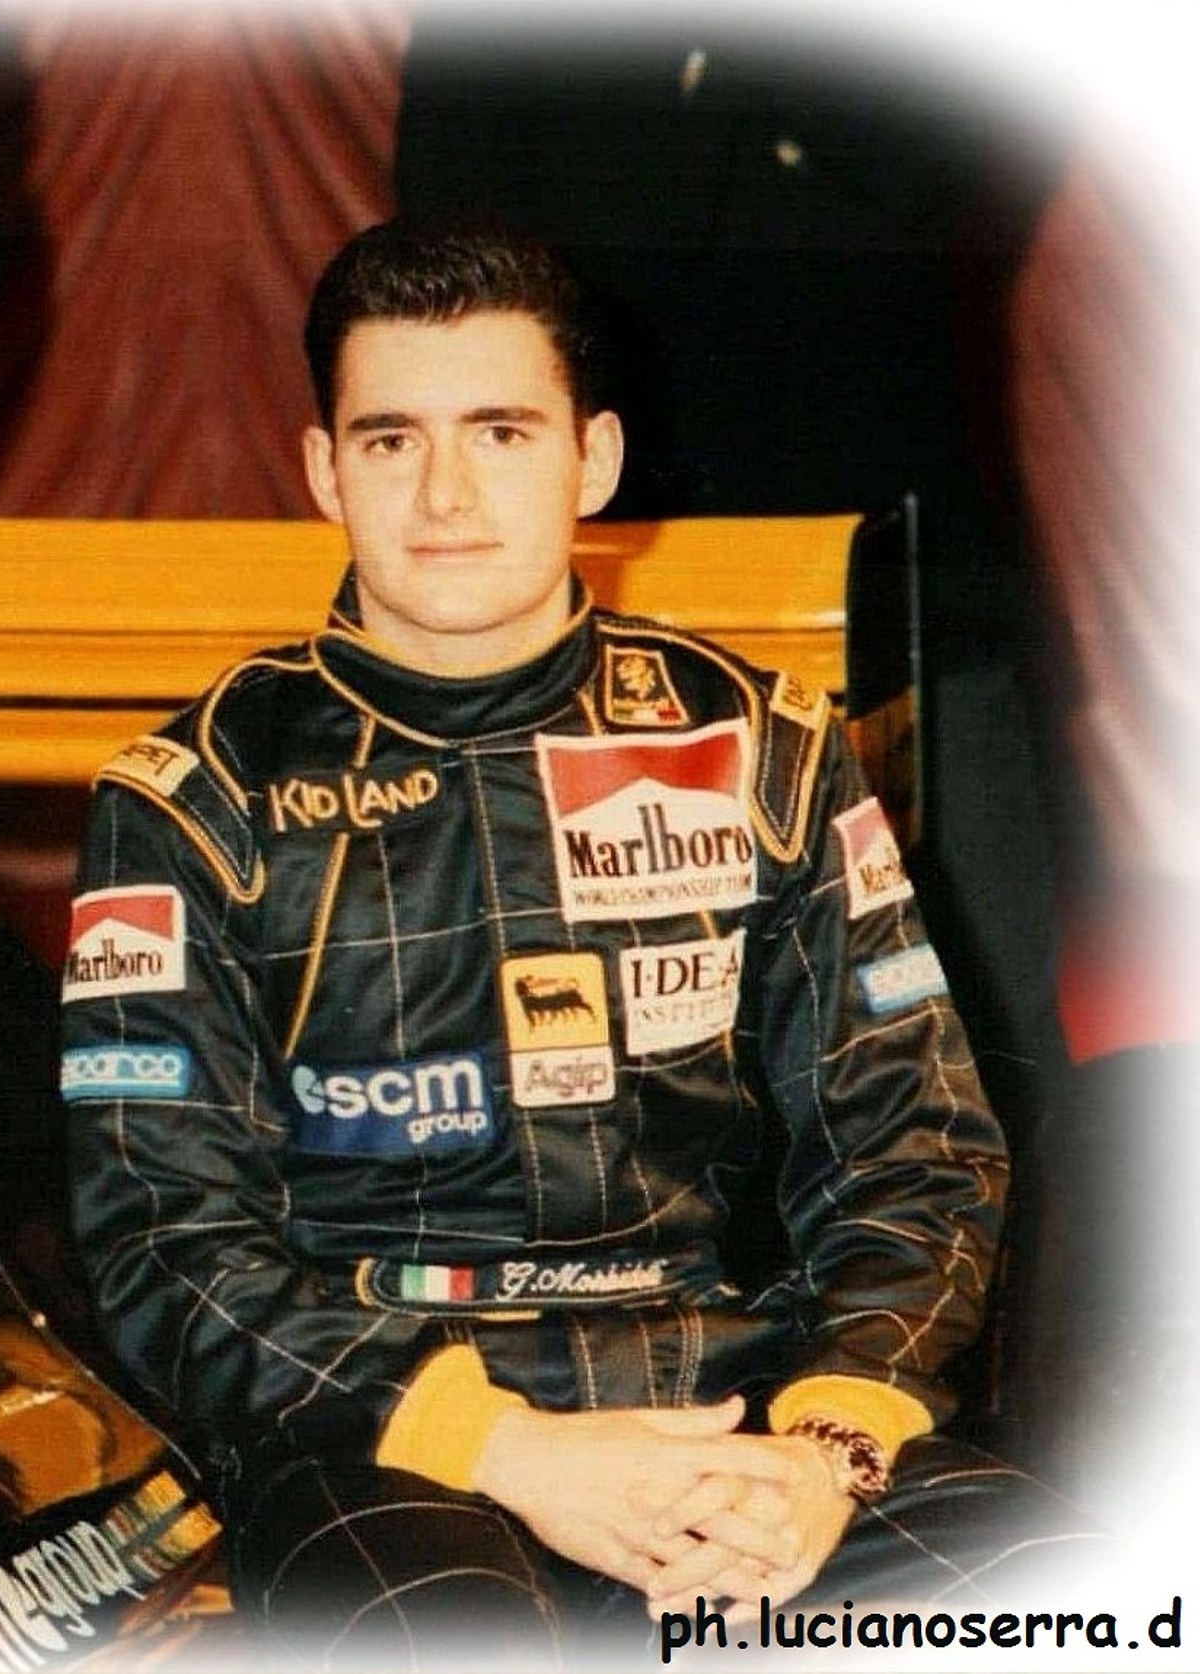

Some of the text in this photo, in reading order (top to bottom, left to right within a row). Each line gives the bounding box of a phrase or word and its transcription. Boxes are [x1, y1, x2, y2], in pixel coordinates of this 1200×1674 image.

[268, 769, 439, 832] KID LAND
[563, 803, 753, 878] Marlboro
[324, 1059, 485, 1119] scm
[406, 1109, 490, 1144] group
